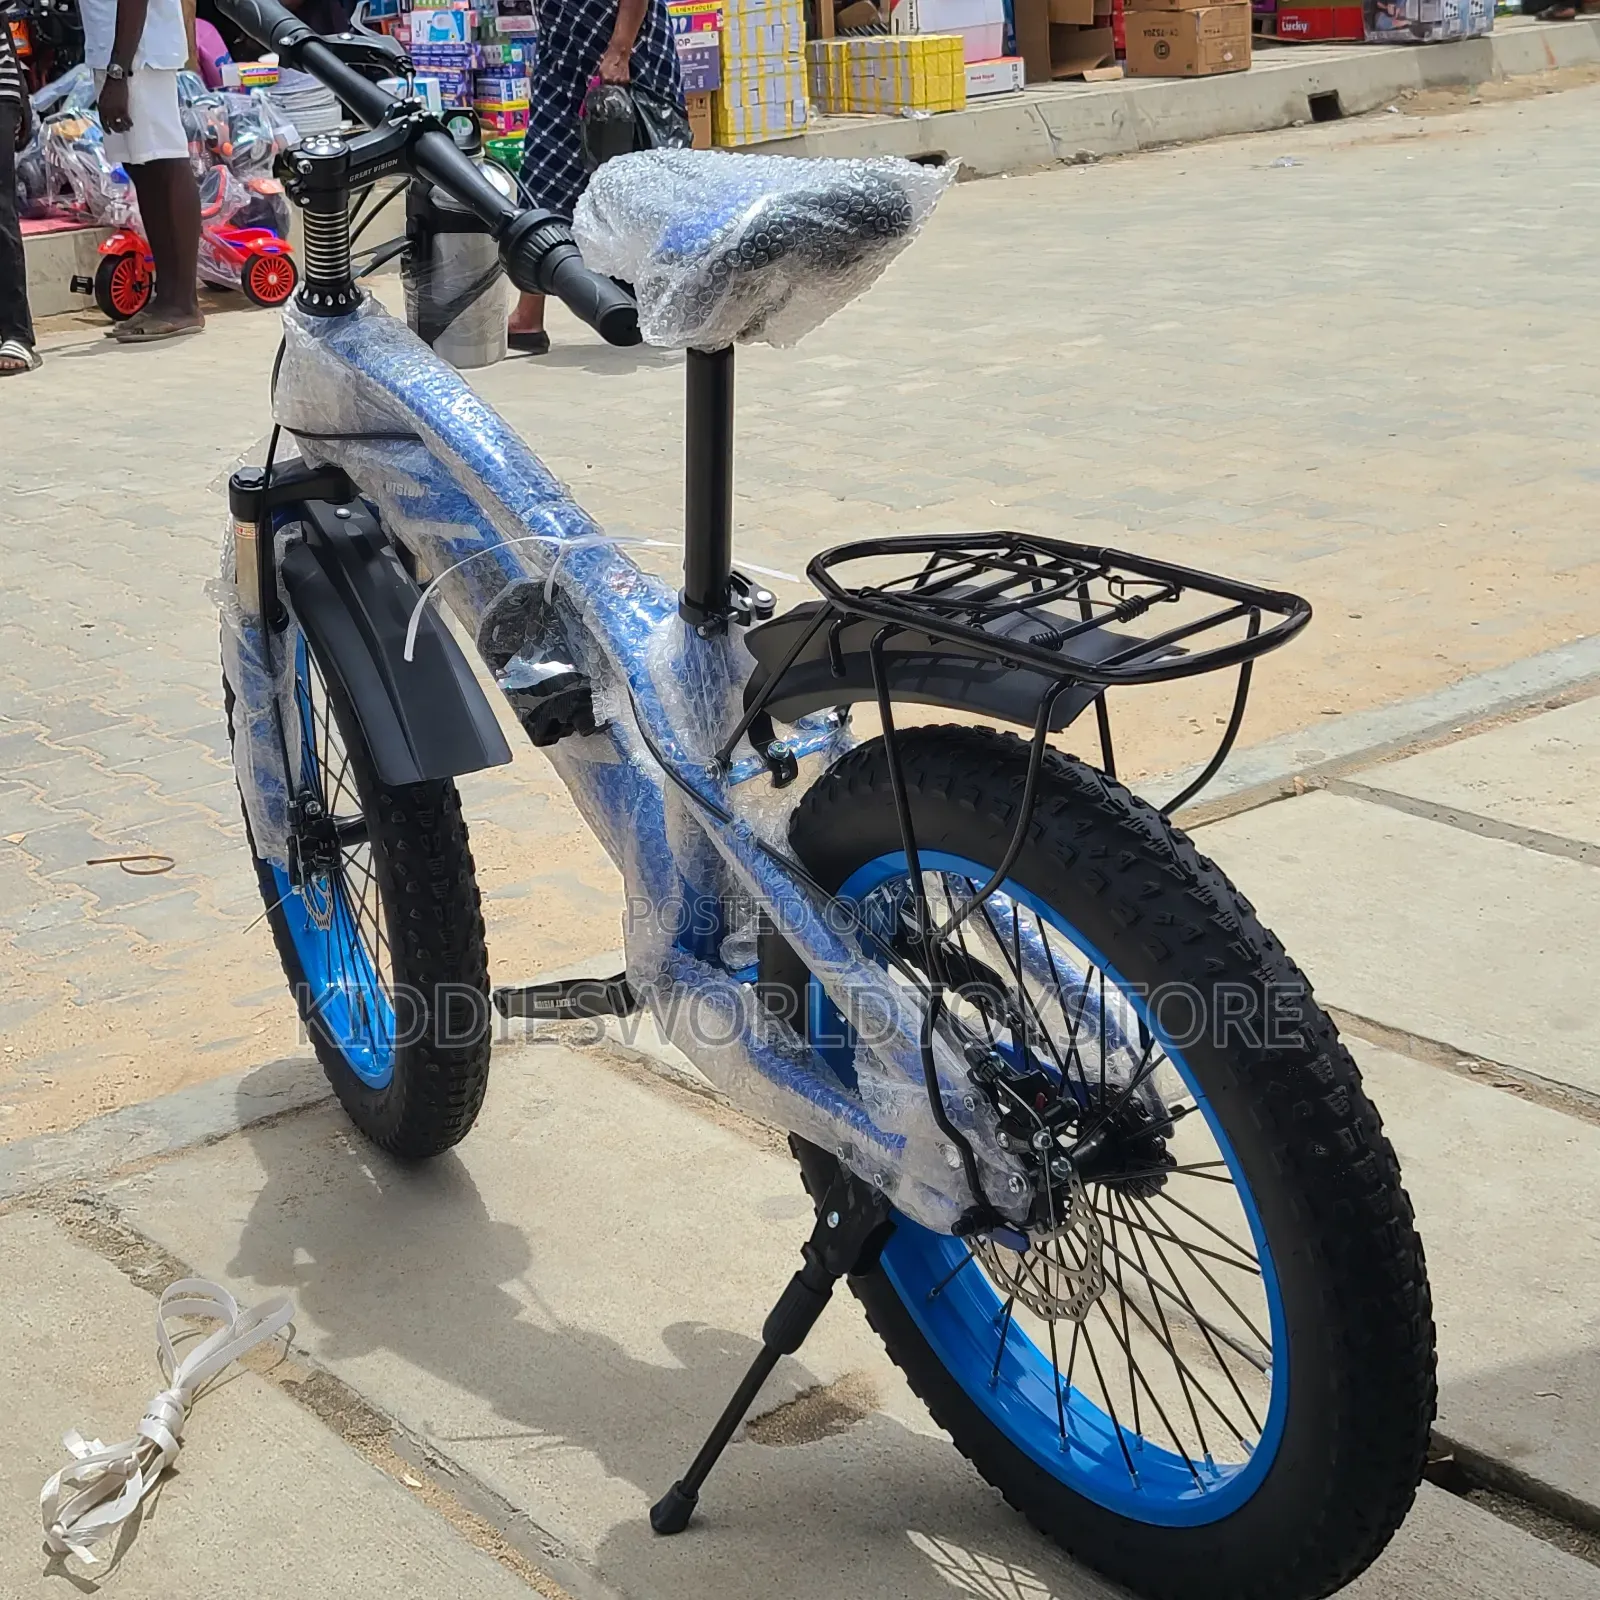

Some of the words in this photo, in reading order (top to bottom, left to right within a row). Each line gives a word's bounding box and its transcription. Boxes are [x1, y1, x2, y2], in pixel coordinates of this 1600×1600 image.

[1281, 21, 1308, 34] Lucky
[349, 168, 372, 182] GREAT
[373, 159, 398, 172] VISION
[385, 481, 426, 498] VISION
